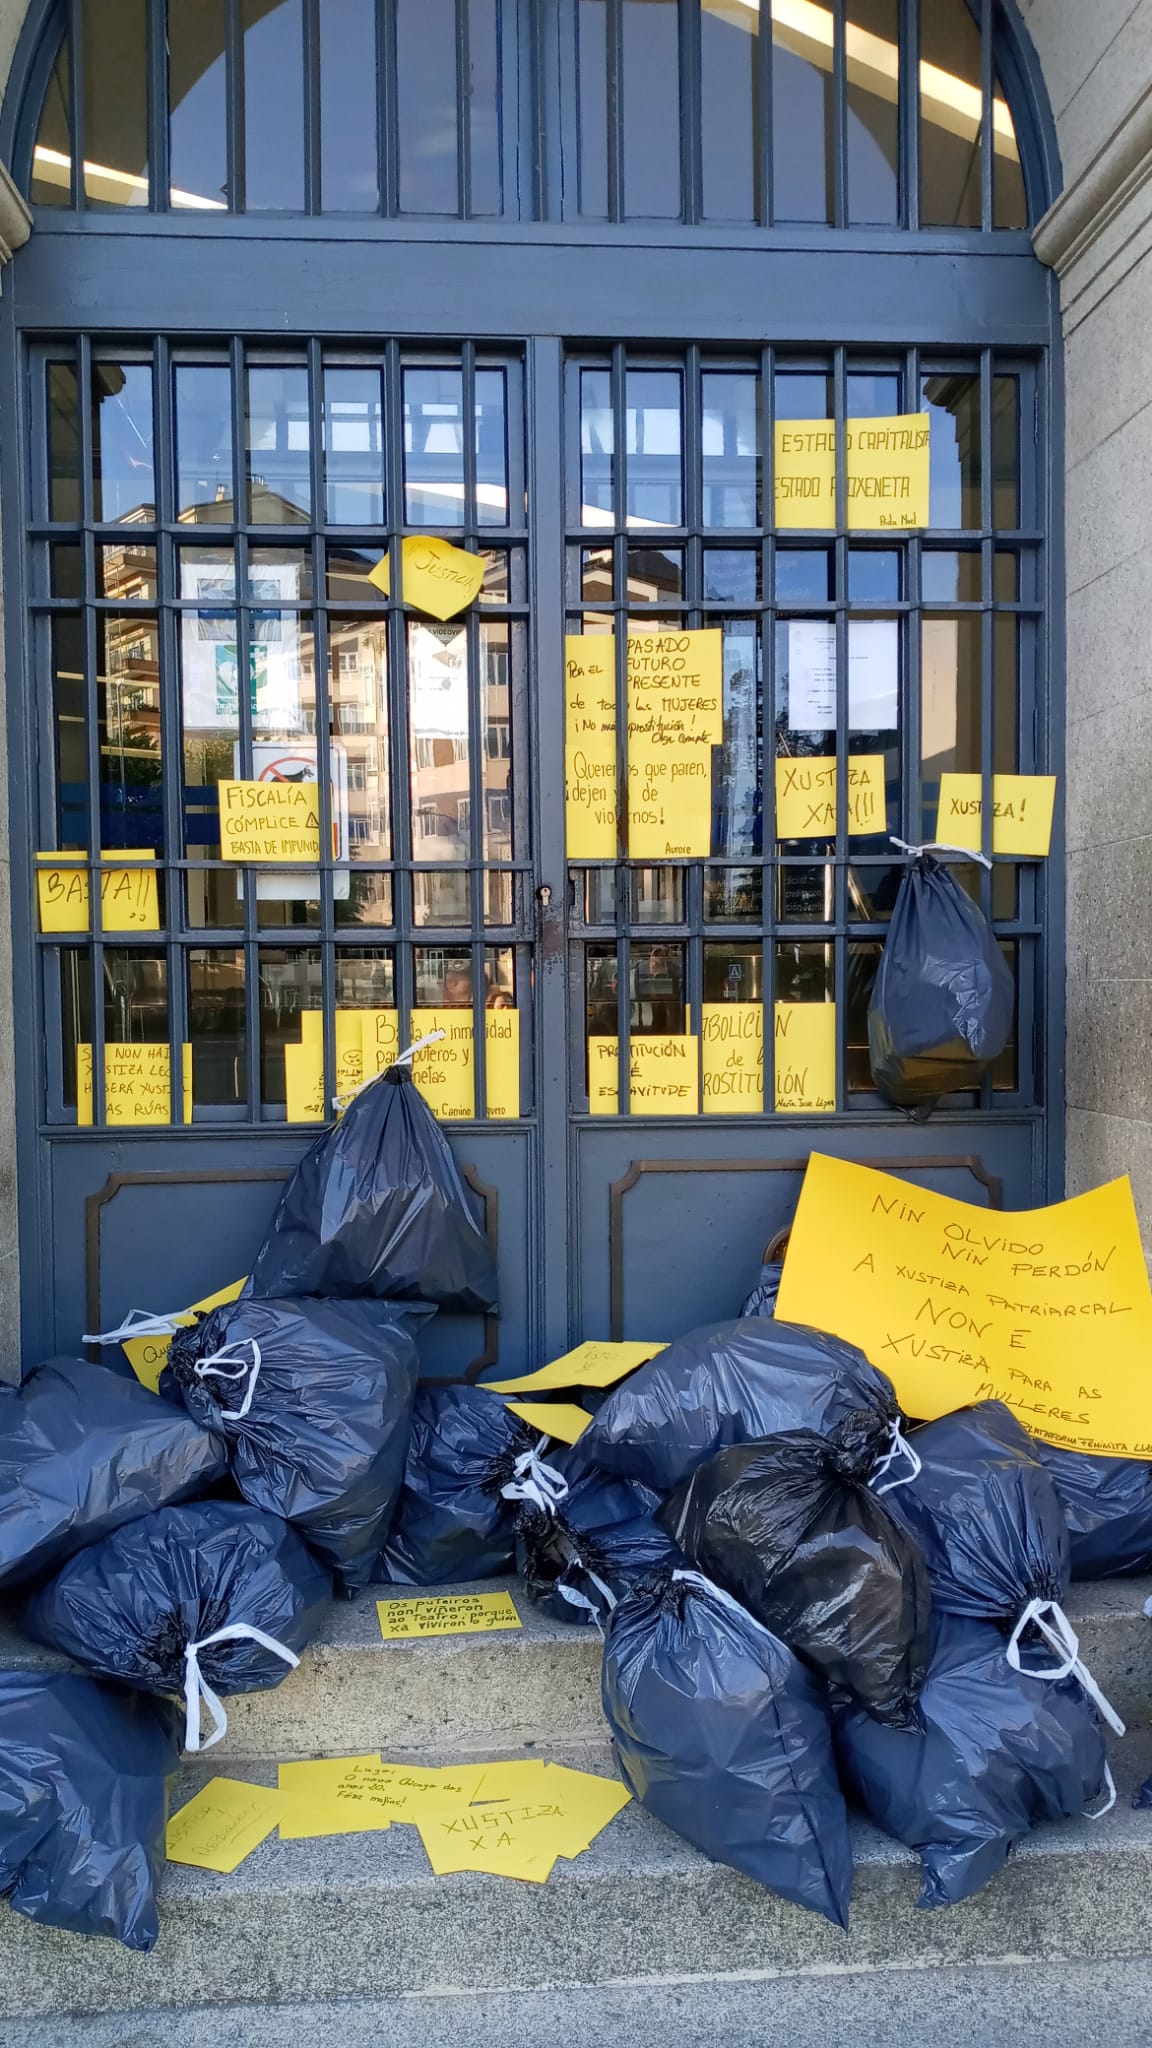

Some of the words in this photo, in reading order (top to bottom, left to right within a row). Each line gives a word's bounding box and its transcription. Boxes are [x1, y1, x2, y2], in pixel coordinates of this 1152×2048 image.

[569, 693, 586, 710] de
[662, 697, 717, 712] MUJERES
[645, 762, 667, 785] que
[783, 767, 871, 797] XUSTZA
[642, 782, 658, 802] de
[231, 841, 261, 856] BASTA
[264, 840, 278, 855] DE
[115, 1047, 142, 1060] NON
[463, 1047, 470, 1067] y
[726, 1048, 745, 1068] de
[943, 1222, 1044, 1256] OLVIDO
[1011, 1245, 1117, 1279] PERDÓN
[853, 1252, 875, 1273] A
[985, 1294, 1133, 1318] PATRIARCAL
[915, 1297, 993, 1338] NON
[881, 1333, 991, 1374] XUSTIZA
[1007, 1367, 1053, 1393] PARA
[1078, 1385, 1103, 1400] AS
